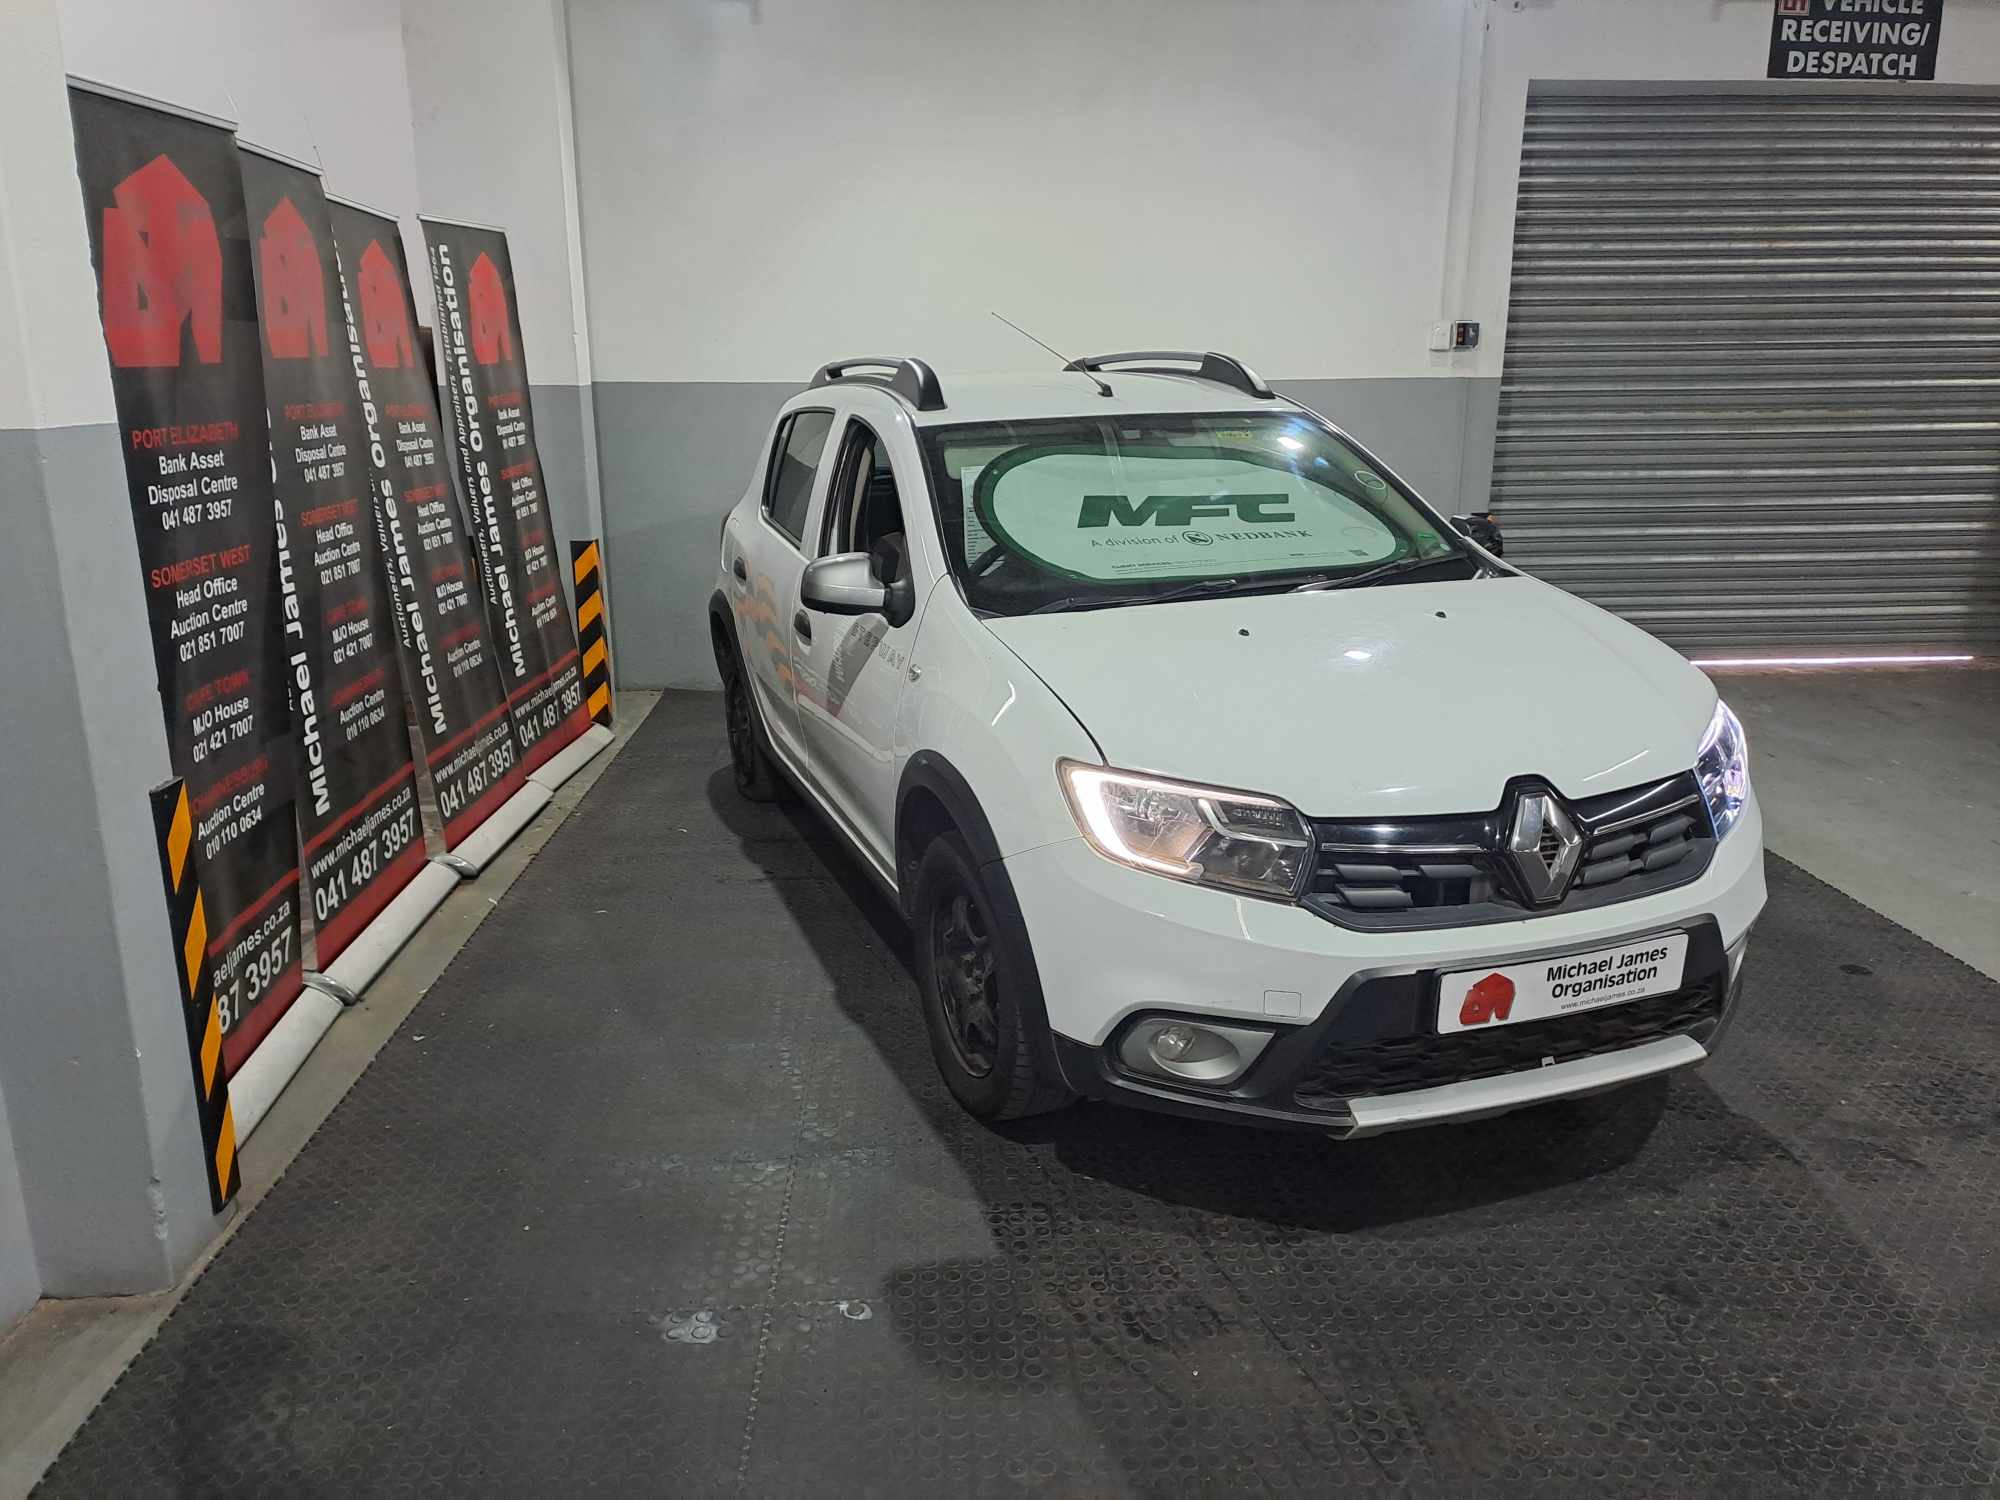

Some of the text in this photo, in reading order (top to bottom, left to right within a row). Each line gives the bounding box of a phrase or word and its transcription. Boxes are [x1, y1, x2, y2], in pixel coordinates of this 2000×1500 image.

[1824, 0, 1924, 15] VEHICLE
[1781, 18, 1932, 46] RECEIVING/
[1786, 51, 1918, 76] DESPATCH
[131, 428, 168, 449] PORT
[300, 424, 319, 441] Bank
[158, 449, 225, 475] Bank Asset
[295, 443, 327, 464] Disposal
[438, 244, 527, 678] Michael James Organisation
[460, 447, 472, 473] and
[148, 474, 238, 505] Disposal Centre
[467, 476, 482, 524] Valuers
[162, 499, 232, 530] 041 487 3957
[1077, 493, 1296, 528] MFC
[316, 526, 334, 544] Head
[381, 479, 415, 592] James
[1091, 528, 1313, 548] A division of NEDBANK
[151, 544, 252, 588] SOMERSET WEST
[314, 546, 341, 566] Auction
[176, 577, 238, 608] Head Office
[170, 597, 248, 639] Auction Centre
[348, 618, 369, 635] House
[179, 621, 245, 662] 021 851 7007
[406, 601, 447, 736] Michael
[192, 710, 213, 737] MJO
[214, 697, 249, 723] House
[519, 680, 582, 748] 041 487 3957
[193, 714, 254, 763] 021 421 7007
[290, 651, 331, 817] Michael
[440, 738, 515, 818] 041 487 3957
[198, 805, 232, 841] Auction
[232, 784, 265, 811] Centre
[205, 805, 263, 860] 010 110 0634
[311, 786, 411, 879] www.michaeljames.co.za
[315, 807, 415, 921] 041 487 3957
[245, 926, 292, 1001] 3957
[1546, 946, 1668, 983] Michael James
[1551, 964, 1659, 999] Organisation
